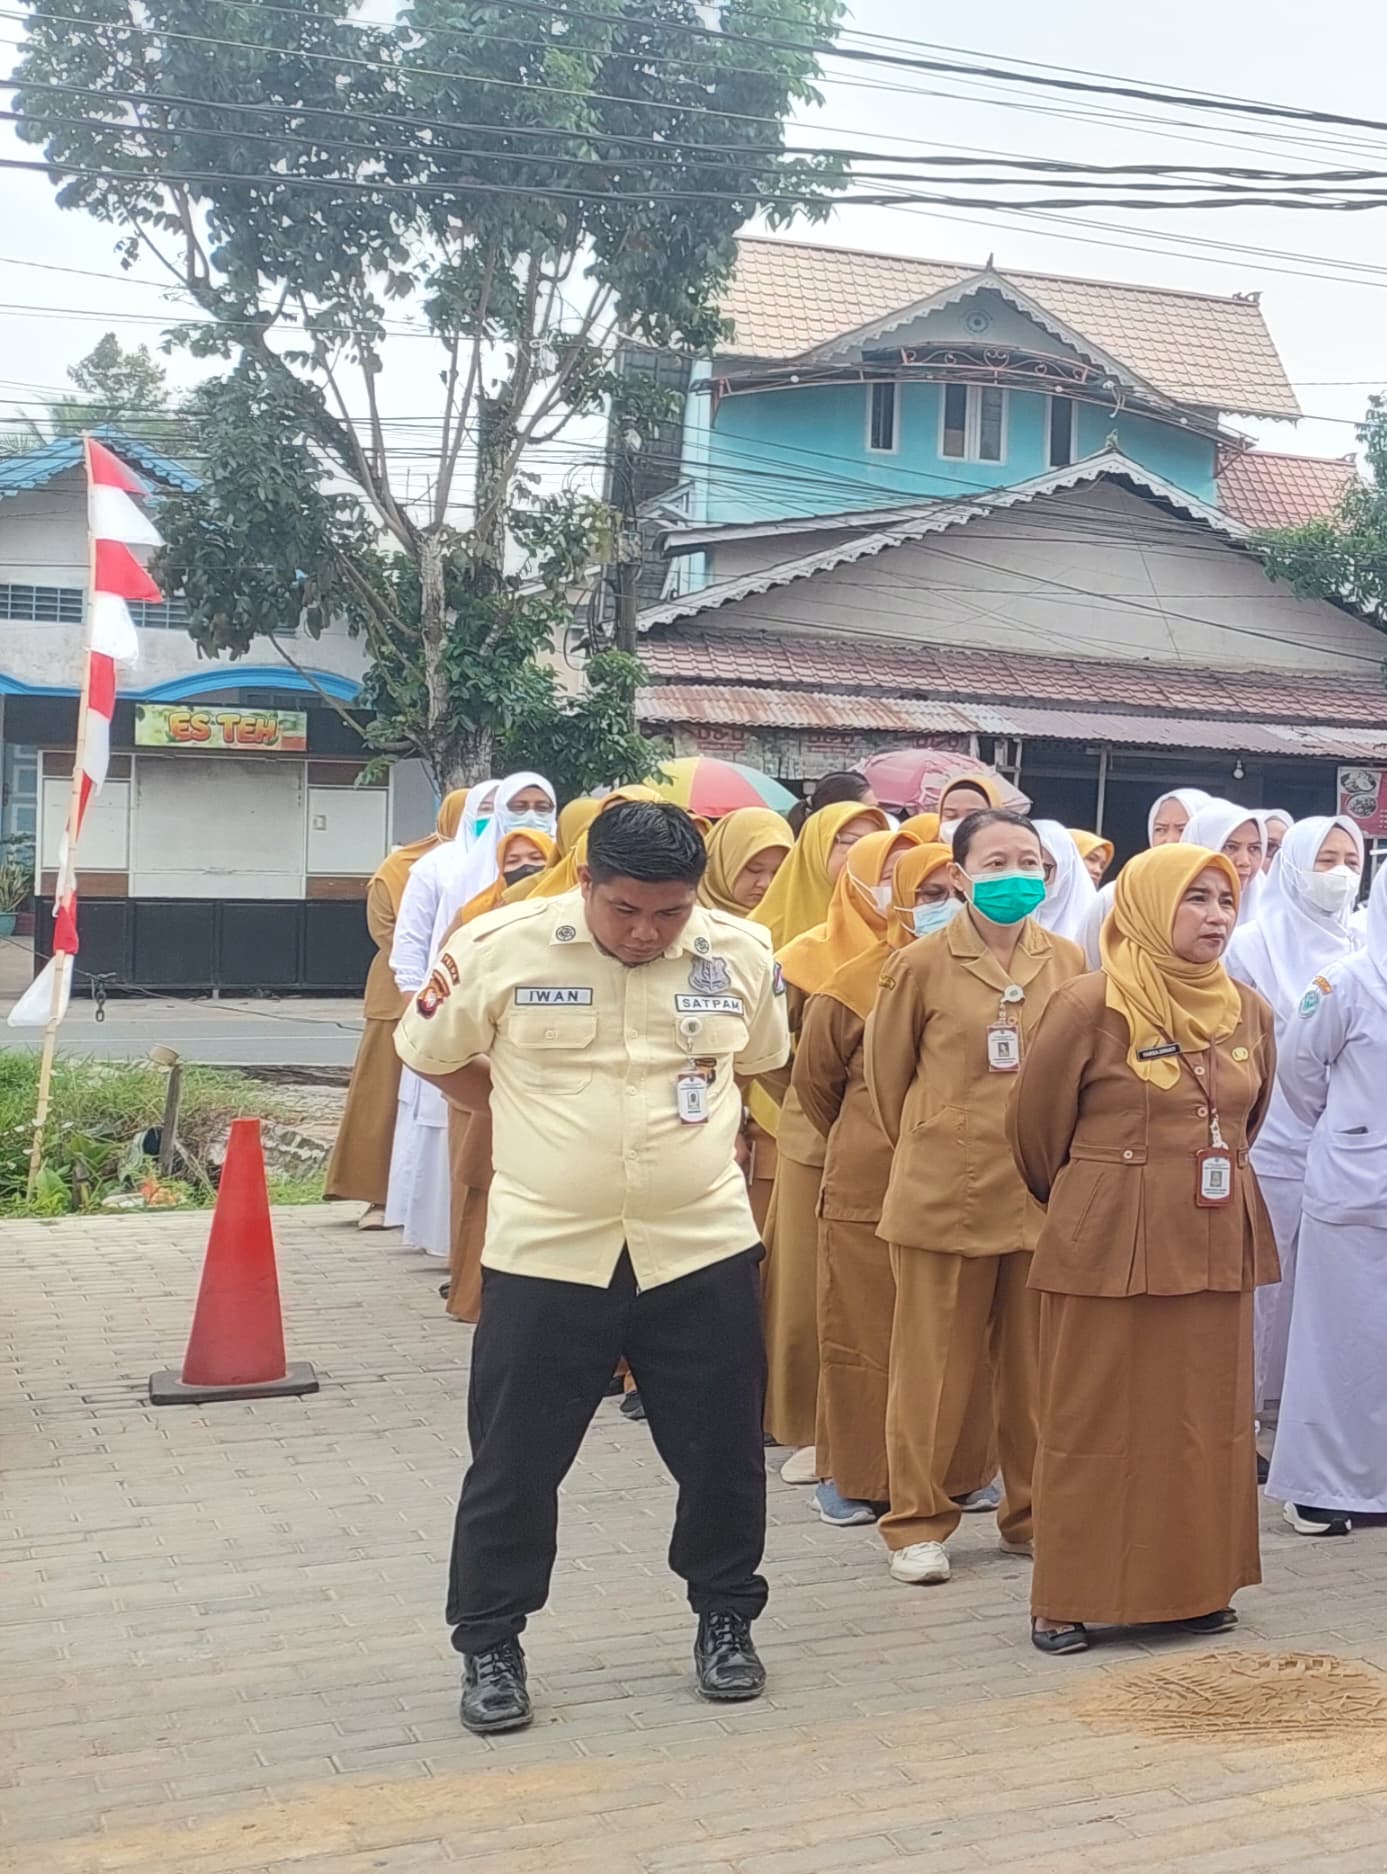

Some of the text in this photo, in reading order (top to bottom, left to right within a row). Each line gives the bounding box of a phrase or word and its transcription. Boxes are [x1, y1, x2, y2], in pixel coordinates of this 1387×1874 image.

[168, 712, 277, 744] ES TEH
[529, 990, 579, 1003] IWAN
[682, 999, 740, 1010] SATPAM
